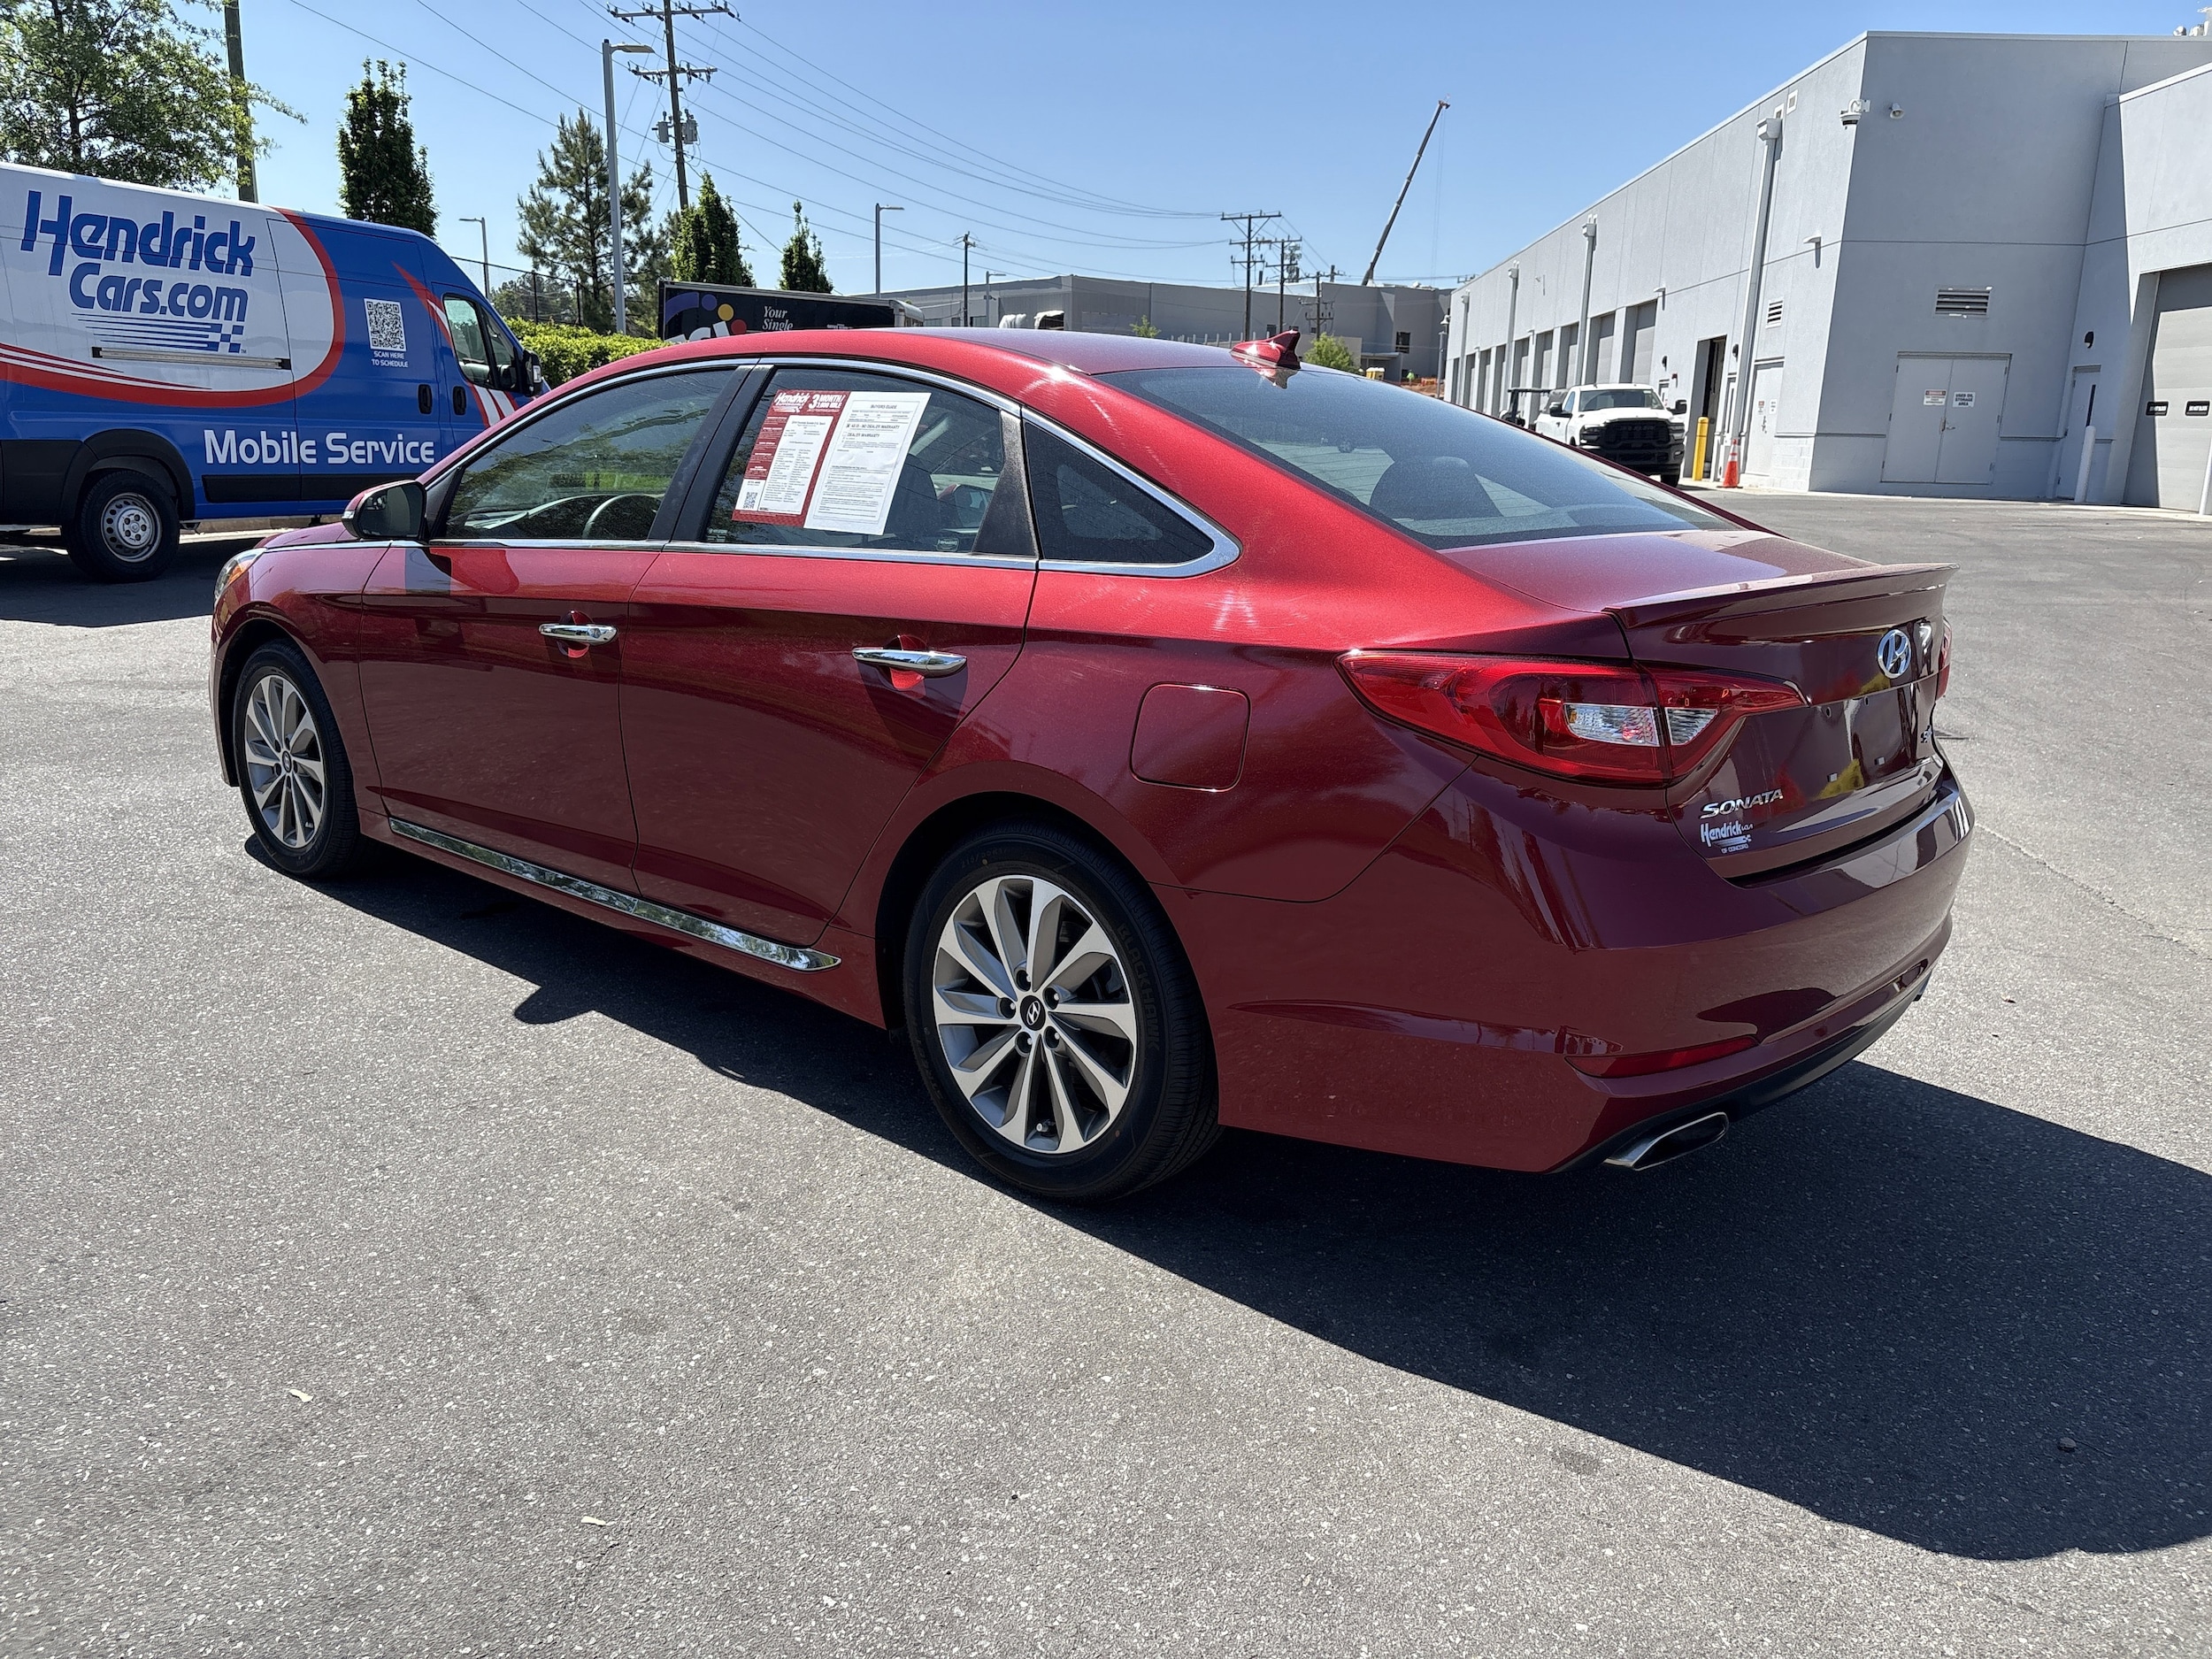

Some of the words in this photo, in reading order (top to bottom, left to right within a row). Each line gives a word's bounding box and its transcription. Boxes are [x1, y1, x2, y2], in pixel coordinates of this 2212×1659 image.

[20, 189, 256, 277] Hendrick
[69, 262, 249, 322] Cars.com
[762, 319, 794, 331] Single
[763, 305, 787, 319] Your
[380, 359, 409, 368] SCHEDULE
[774, 392, 810, 405] Hendrick
[809, 394, 820, 409] 3
[204, 429, 317, 465] Mobile
[326, 432, 435, 465] Service
[1700, 788, 1784, 819] SONATA
[1700, 820, 1742, 848] Hendrick
[1117, 922, 1161, 1051] BLACKHAWK
